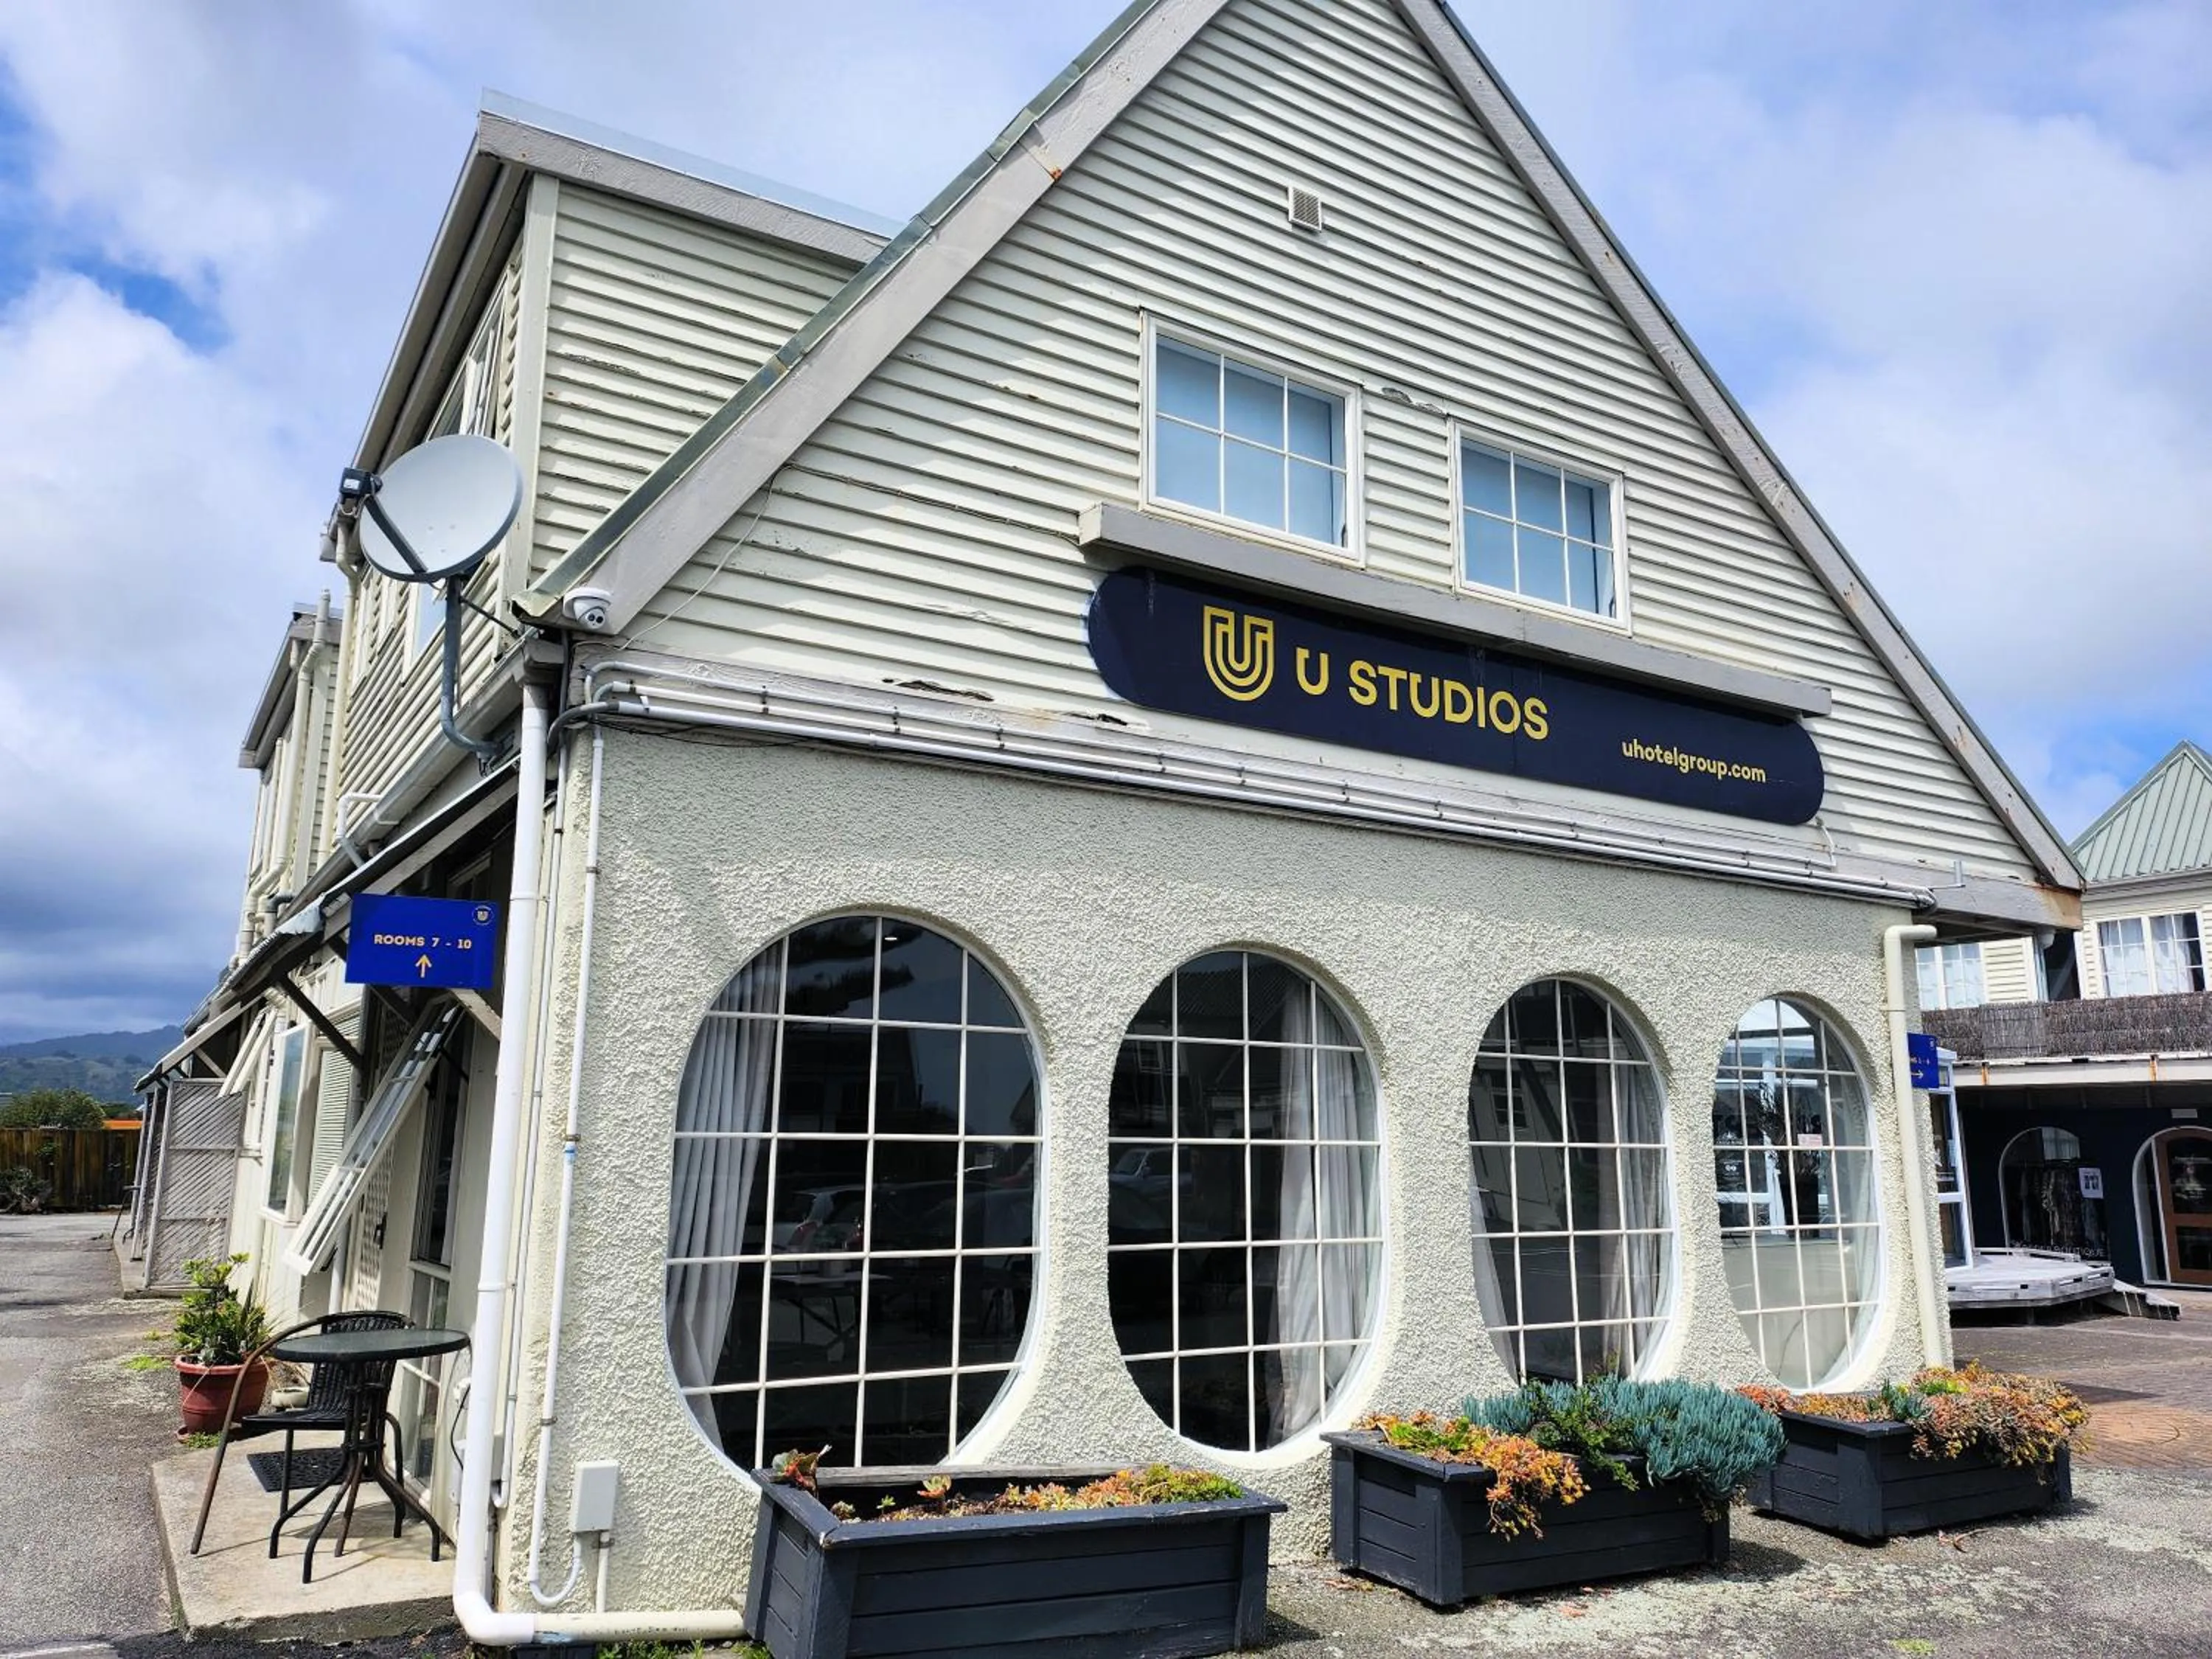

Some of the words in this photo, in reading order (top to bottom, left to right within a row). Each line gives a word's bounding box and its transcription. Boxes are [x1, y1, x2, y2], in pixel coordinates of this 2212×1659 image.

[1296, 647, 1329, 695] U
[1349, 660, 1548, 740] STUDIOS
[1621, 738, 1766, 783] uhotelgroup.com
[374, 934, 425, 947] ROOMS
[432, 937, 440, 947] 7
[457, 939, 473, 950] 10
